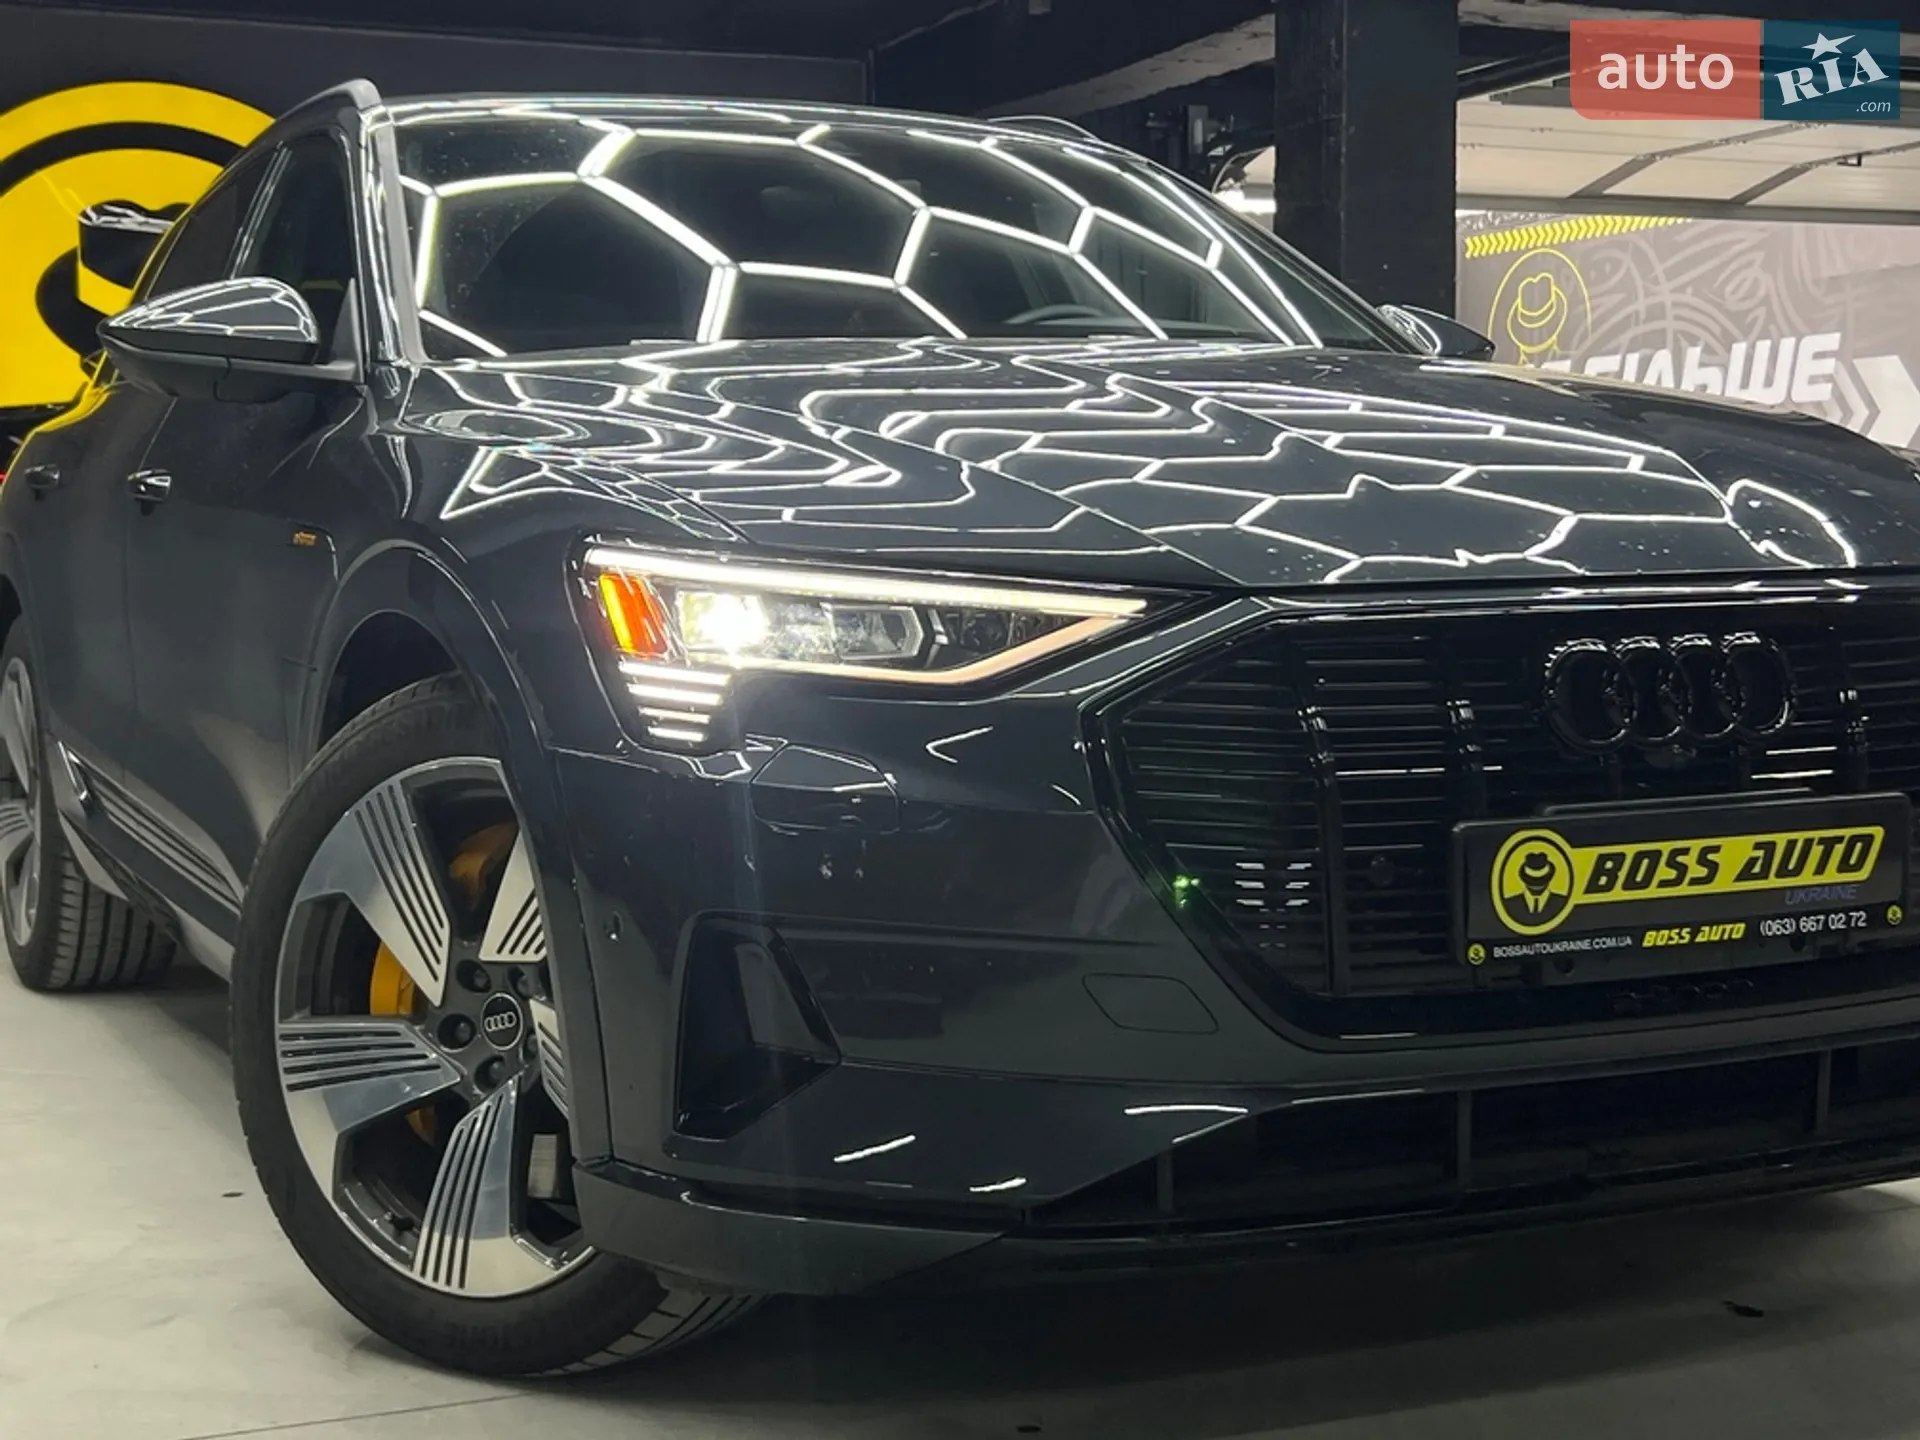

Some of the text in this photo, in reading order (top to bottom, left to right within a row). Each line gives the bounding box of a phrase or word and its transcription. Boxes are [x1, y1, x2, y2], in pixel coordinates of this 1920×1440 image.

[1582, 834, 1875, 895] BOSS AUTO
[1785, 884, 1859, 905] UKRAINE
[1642, 923, 1747, 948] BOSS AUTO
[1760, 911, 1868, 937] (063) 667 02 72
[1493, 936, 1633, 958] BOSSAUTOUKRAINE.COM.UA
